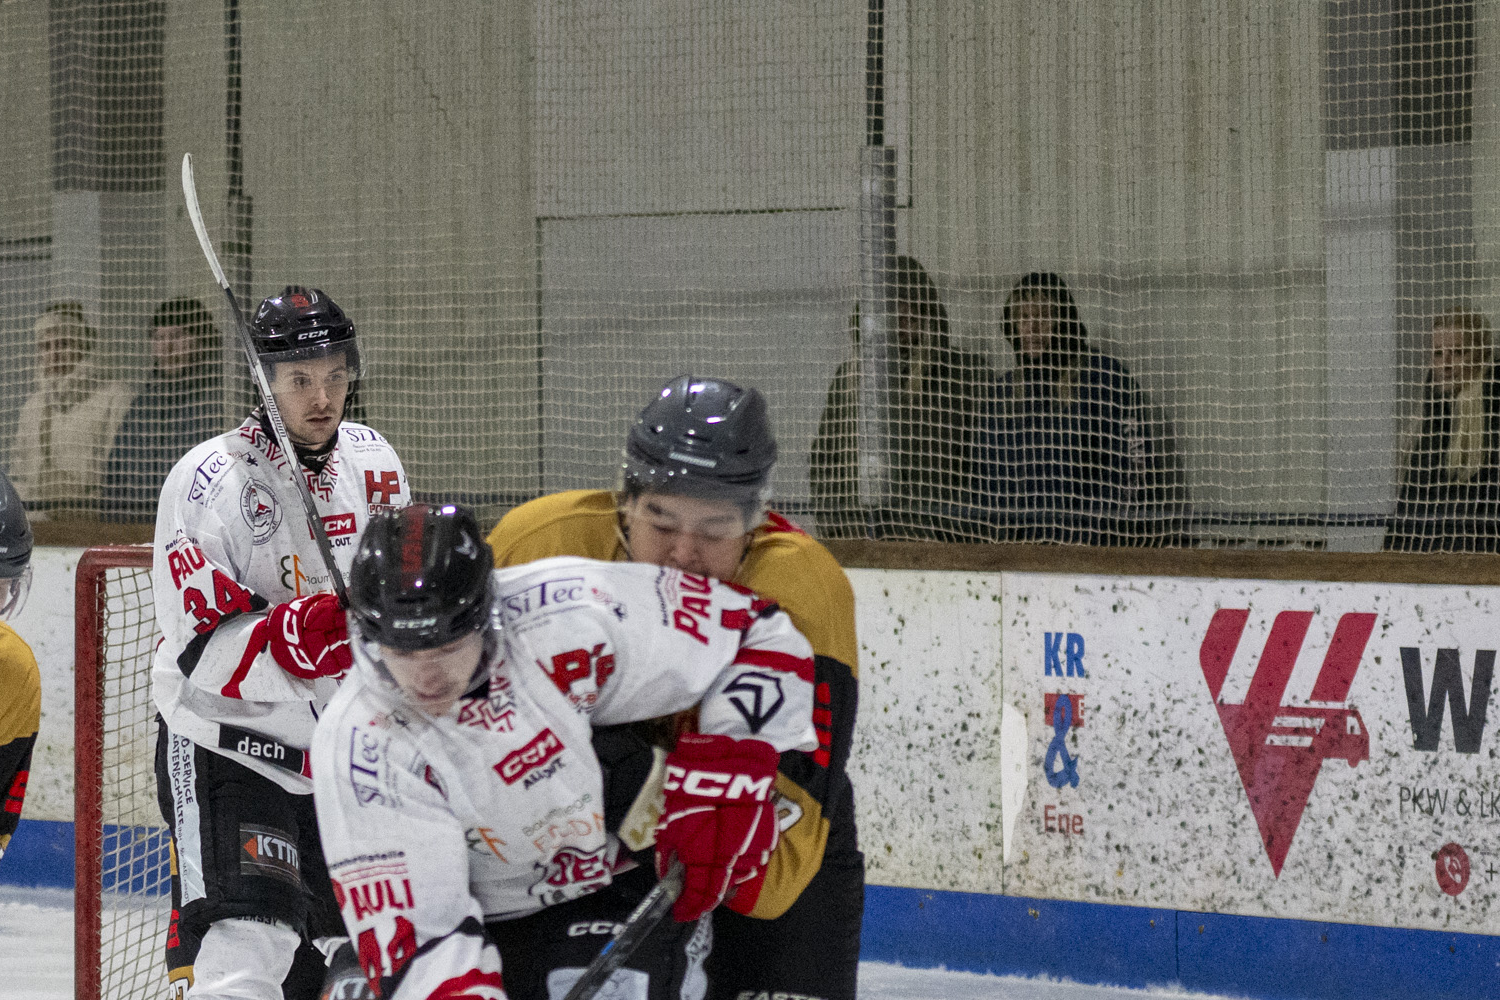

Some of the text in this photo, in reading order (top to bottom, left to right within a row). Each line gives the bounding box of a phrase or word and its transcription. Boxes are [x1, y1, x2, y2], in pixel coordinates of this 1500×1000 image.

[297, 328, 330, 341] CCM
[324, 518, 352, 532] CM
[183, 568, 253, 635] 34
[1043, 632, 1086, 678] KR
[1398, 646, 1497, 755] W
[237, 736, 286, 760] dach
[179, 735, 195, 806] O-SERVICE
[663, 765, 773, 801] CCM
[1400, 786, 1449, 816] PKW
[1455, 788, 1472, 817] &
[348, 878, 414, 922] AULI
